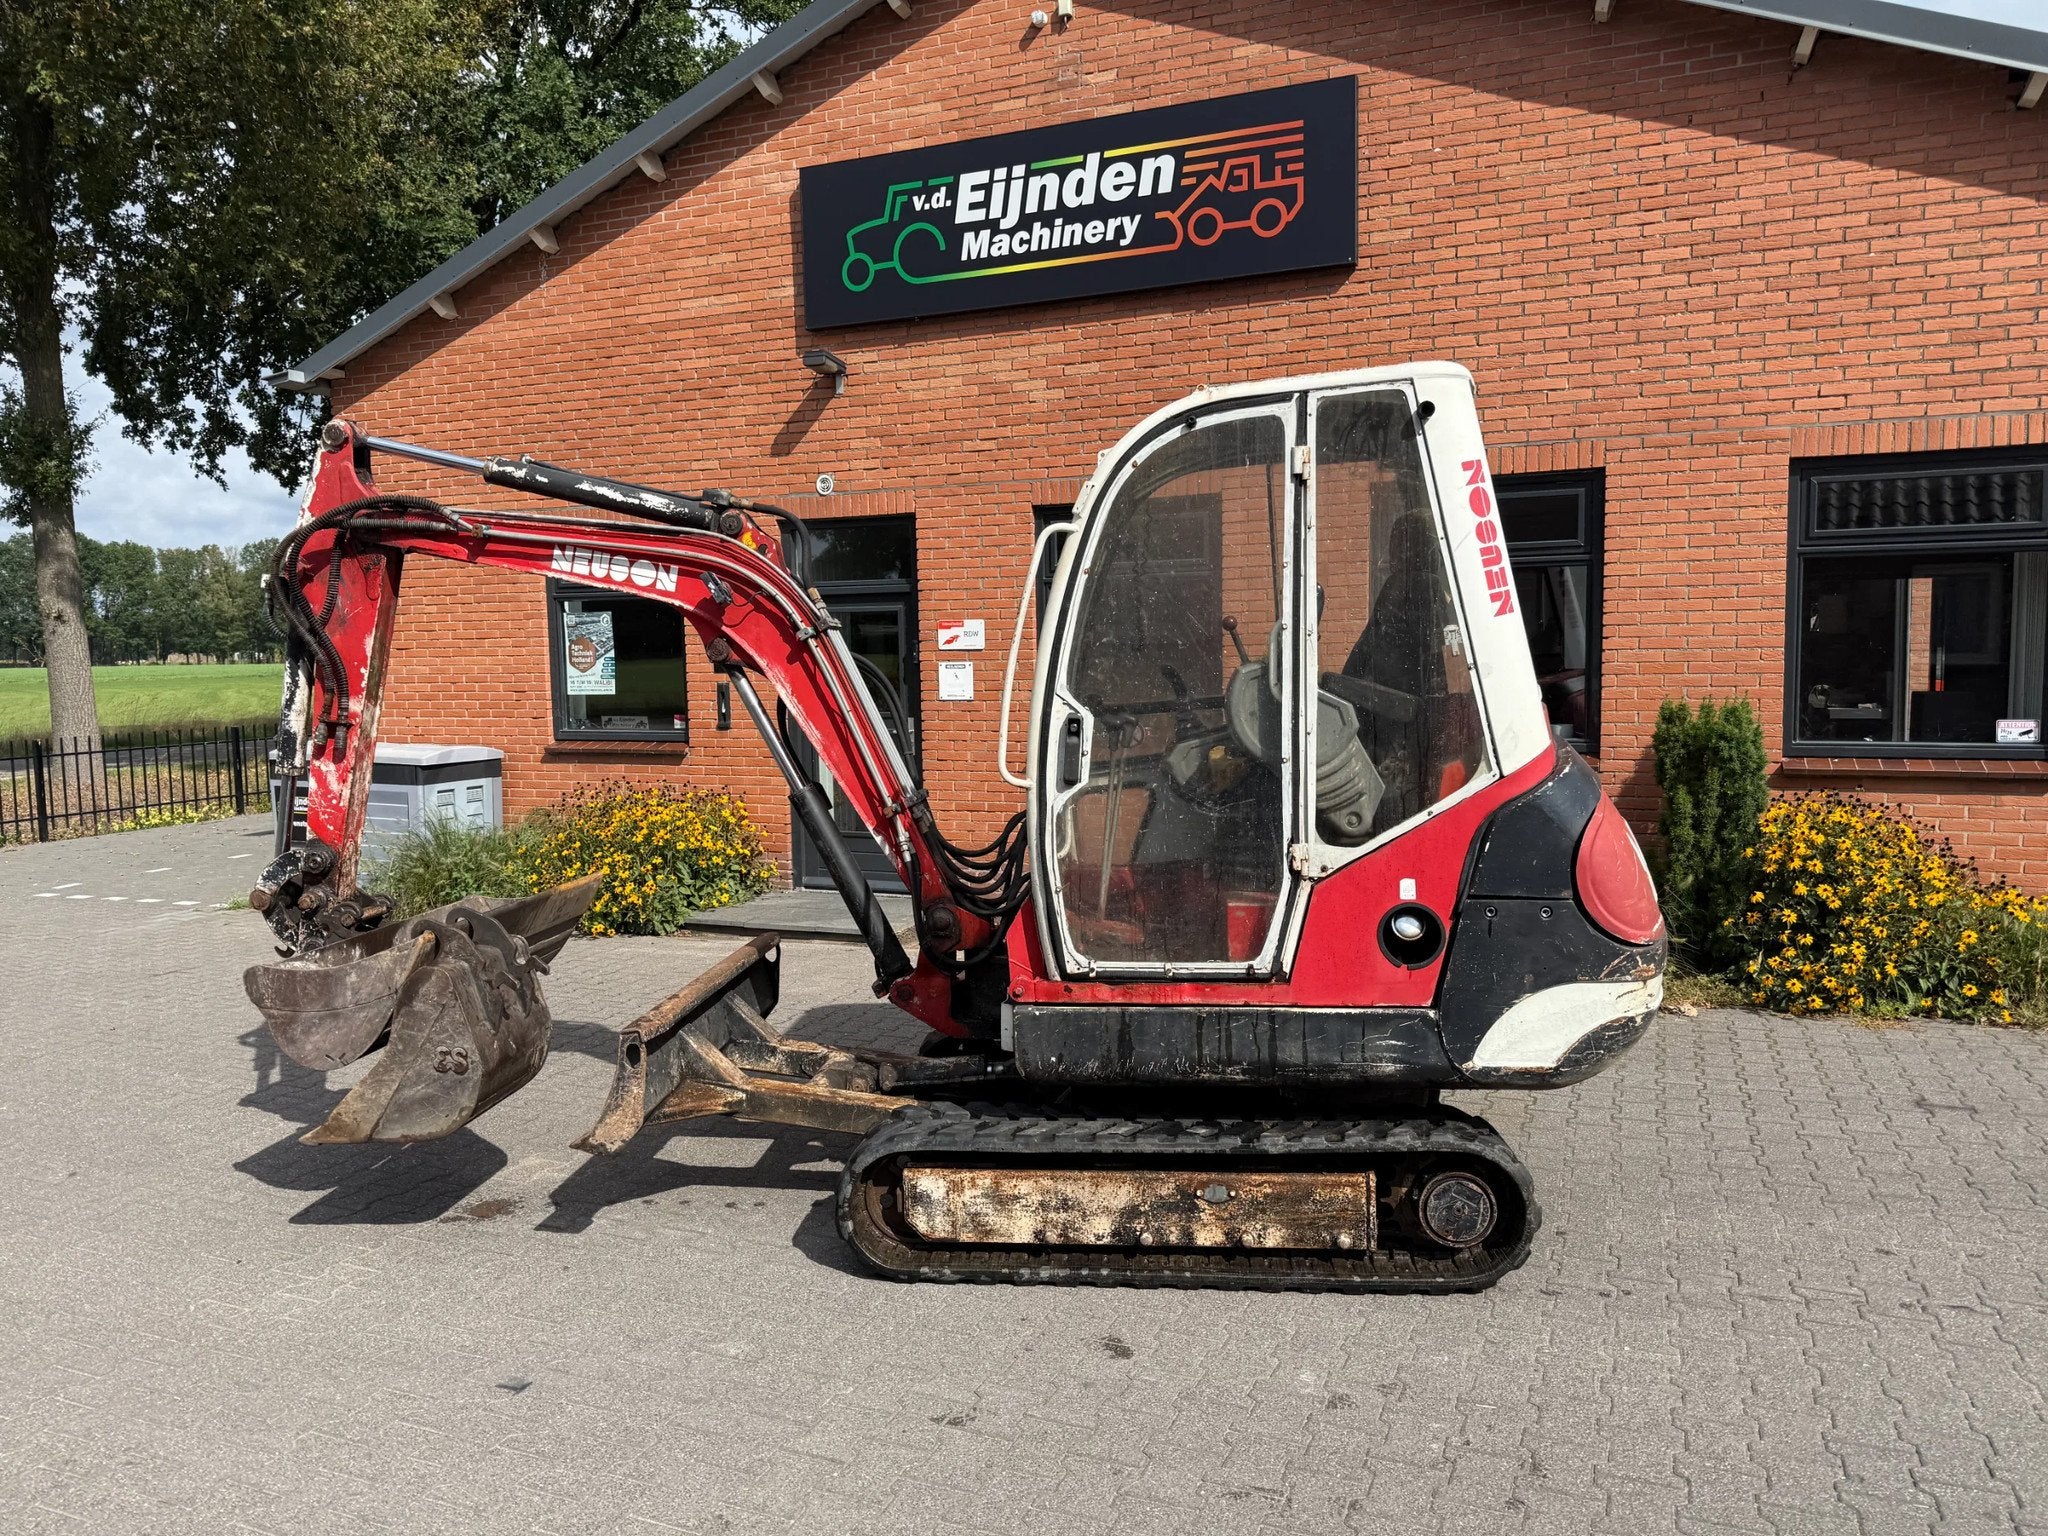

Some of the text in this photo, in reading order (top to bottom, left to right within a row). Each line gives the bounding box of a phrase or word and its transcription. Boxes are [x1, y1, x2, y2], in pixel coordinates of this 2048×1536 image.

[912, 151, 1176, 230] v.d. Eijnden
[960, 213, 1142, 262] Machinery
[1461, 459, 1515, 618] NEUSON
[551, 544, 679, 592] NEUSON
[963, 630, 979, 638] RDW
